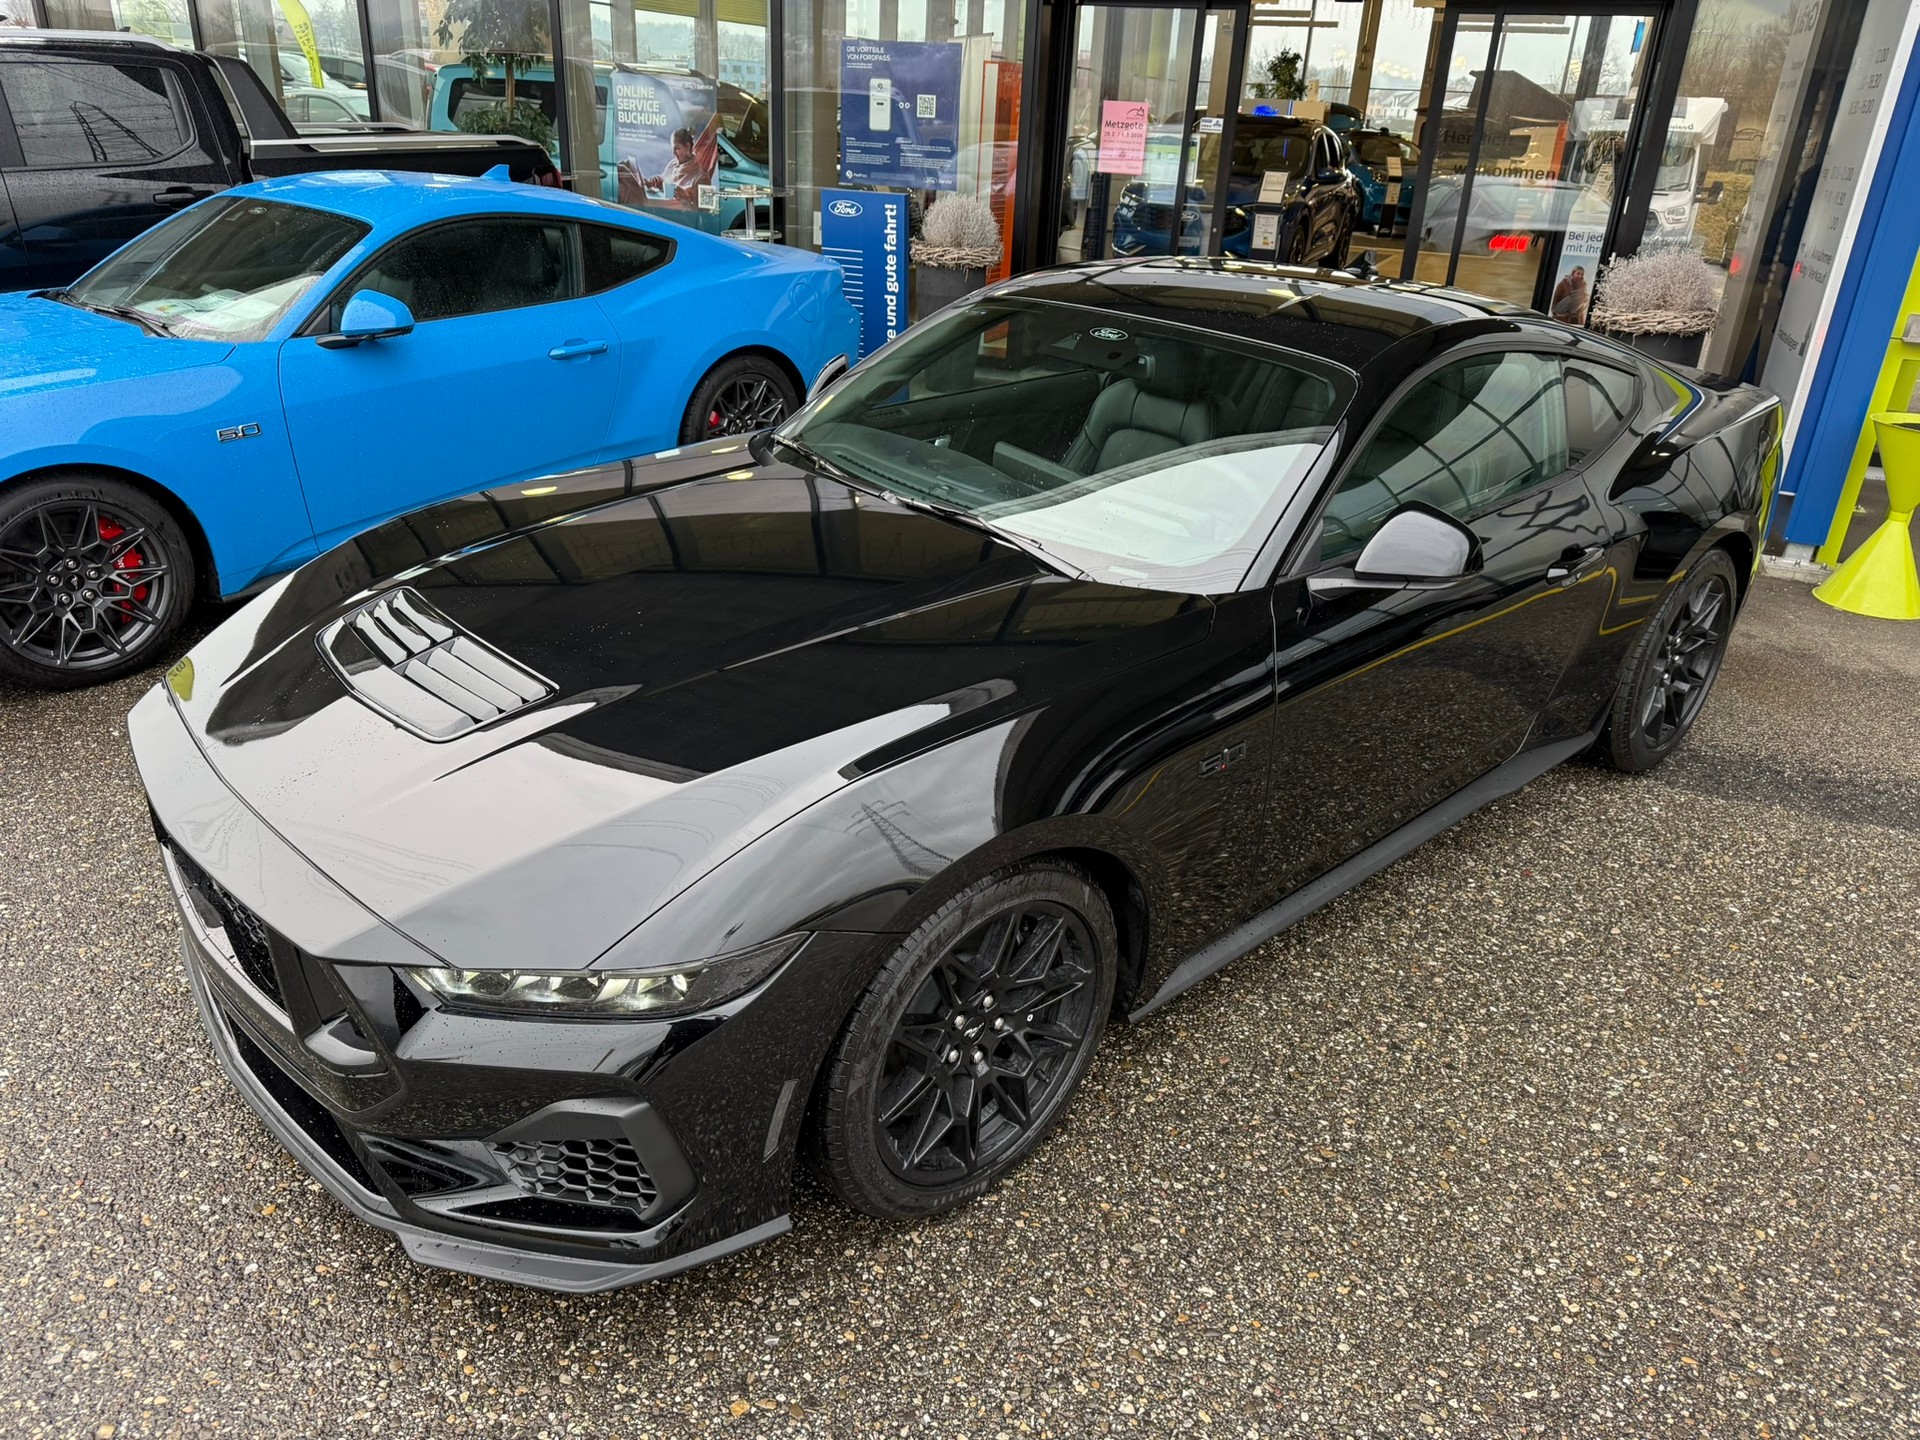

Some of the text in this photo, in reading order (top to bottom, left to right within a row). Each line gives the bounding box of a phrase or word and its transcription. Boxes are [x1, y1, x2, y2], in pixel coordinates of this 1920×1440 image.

[857, 46, 885, 54] VORTEILE
[616, 84, 655, 99] ONLINE
[617, 98, 660, 112] SERVICE
[618, 111, 667, 126] BUCHUNG
[1104, 119, 1144, 130] Metzgete
[1443, 129, 1512, 146] Herlich
[1454, 164, 1555, 180] wllkommen
[832, 201, 859, 215] Ford
[884, 203, 897, 251] fahrt!
[1568, 231, 1585, 241] Bei
[1566, 242, 1583, 253] mit
[884, 254, 899, 293] gute
[884, 295, 897, 326] und
[1092, 328, 1125, 340] Ford
[216, 422, 261, 442] 5.0
[1199, 740, 1247, 778] 5.0
